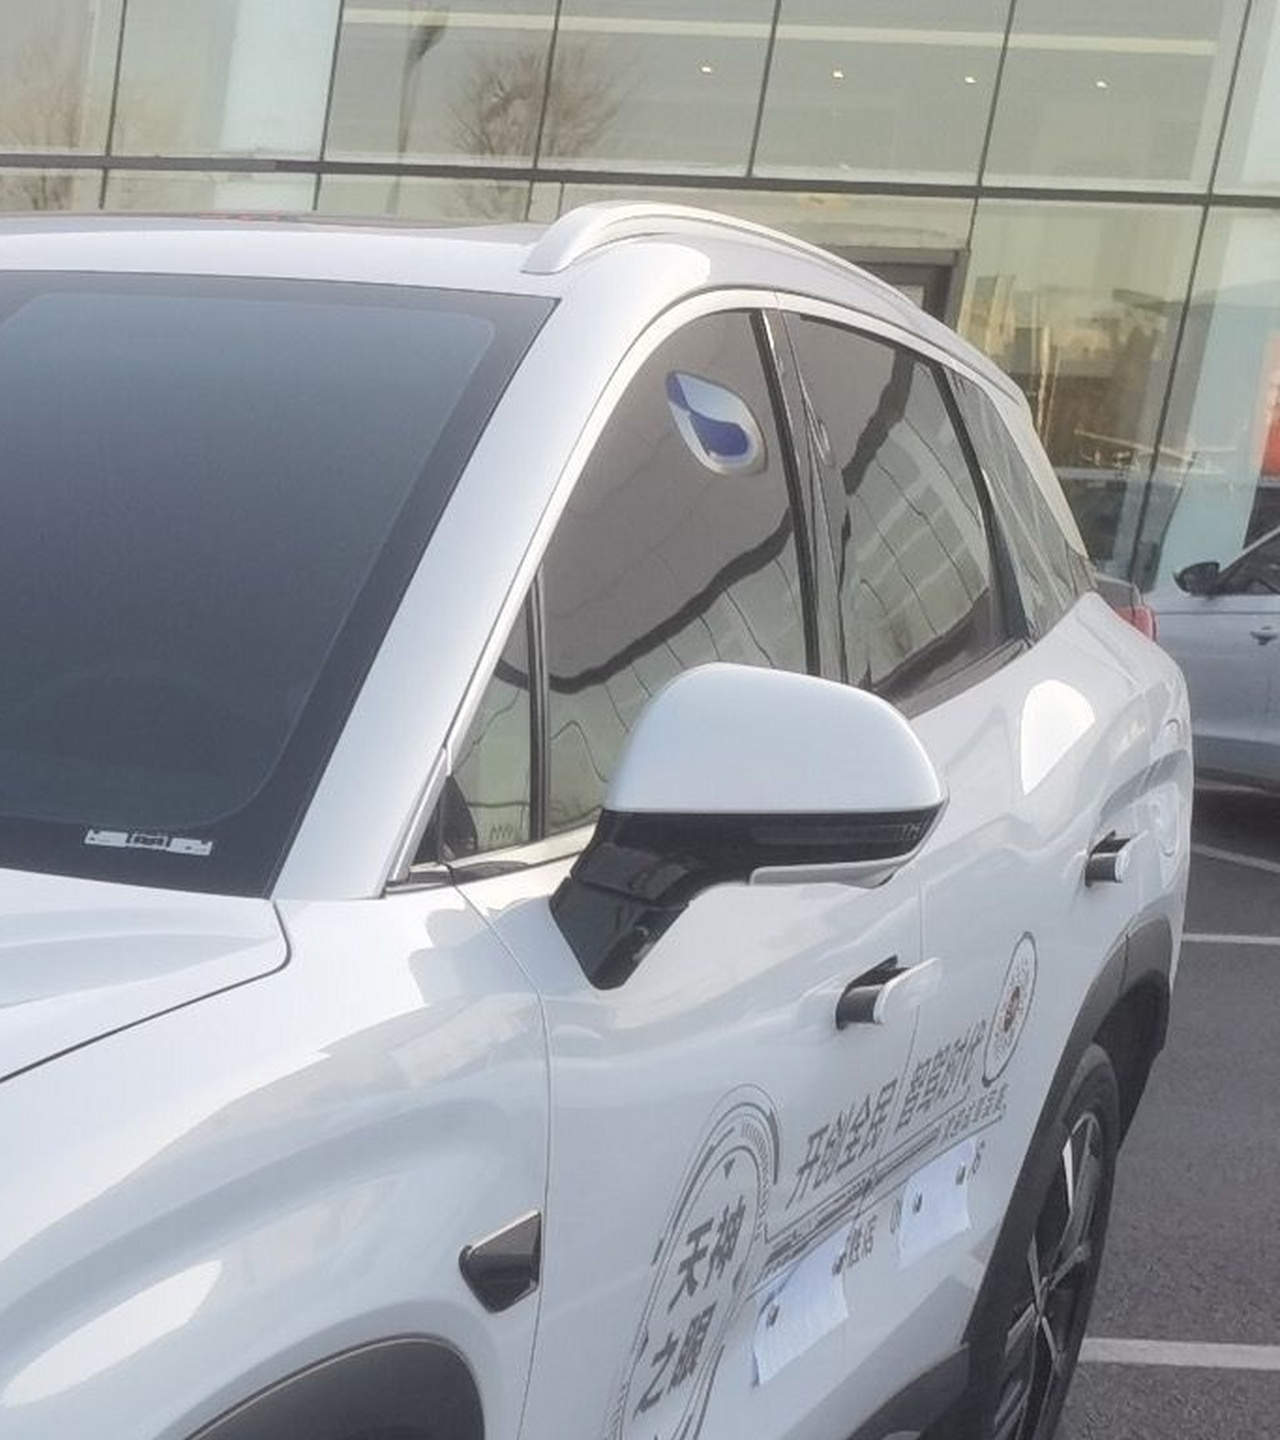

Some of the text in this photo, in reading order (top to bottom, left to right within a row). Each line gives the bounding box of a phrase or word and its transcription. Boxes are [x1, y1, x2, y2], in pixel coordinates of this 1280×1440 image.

[785, 1077, 898, 1212] 开创全民
[667, 1194, 746, 1316] 天神
[632, 1301, 717, 1421] 之眼
